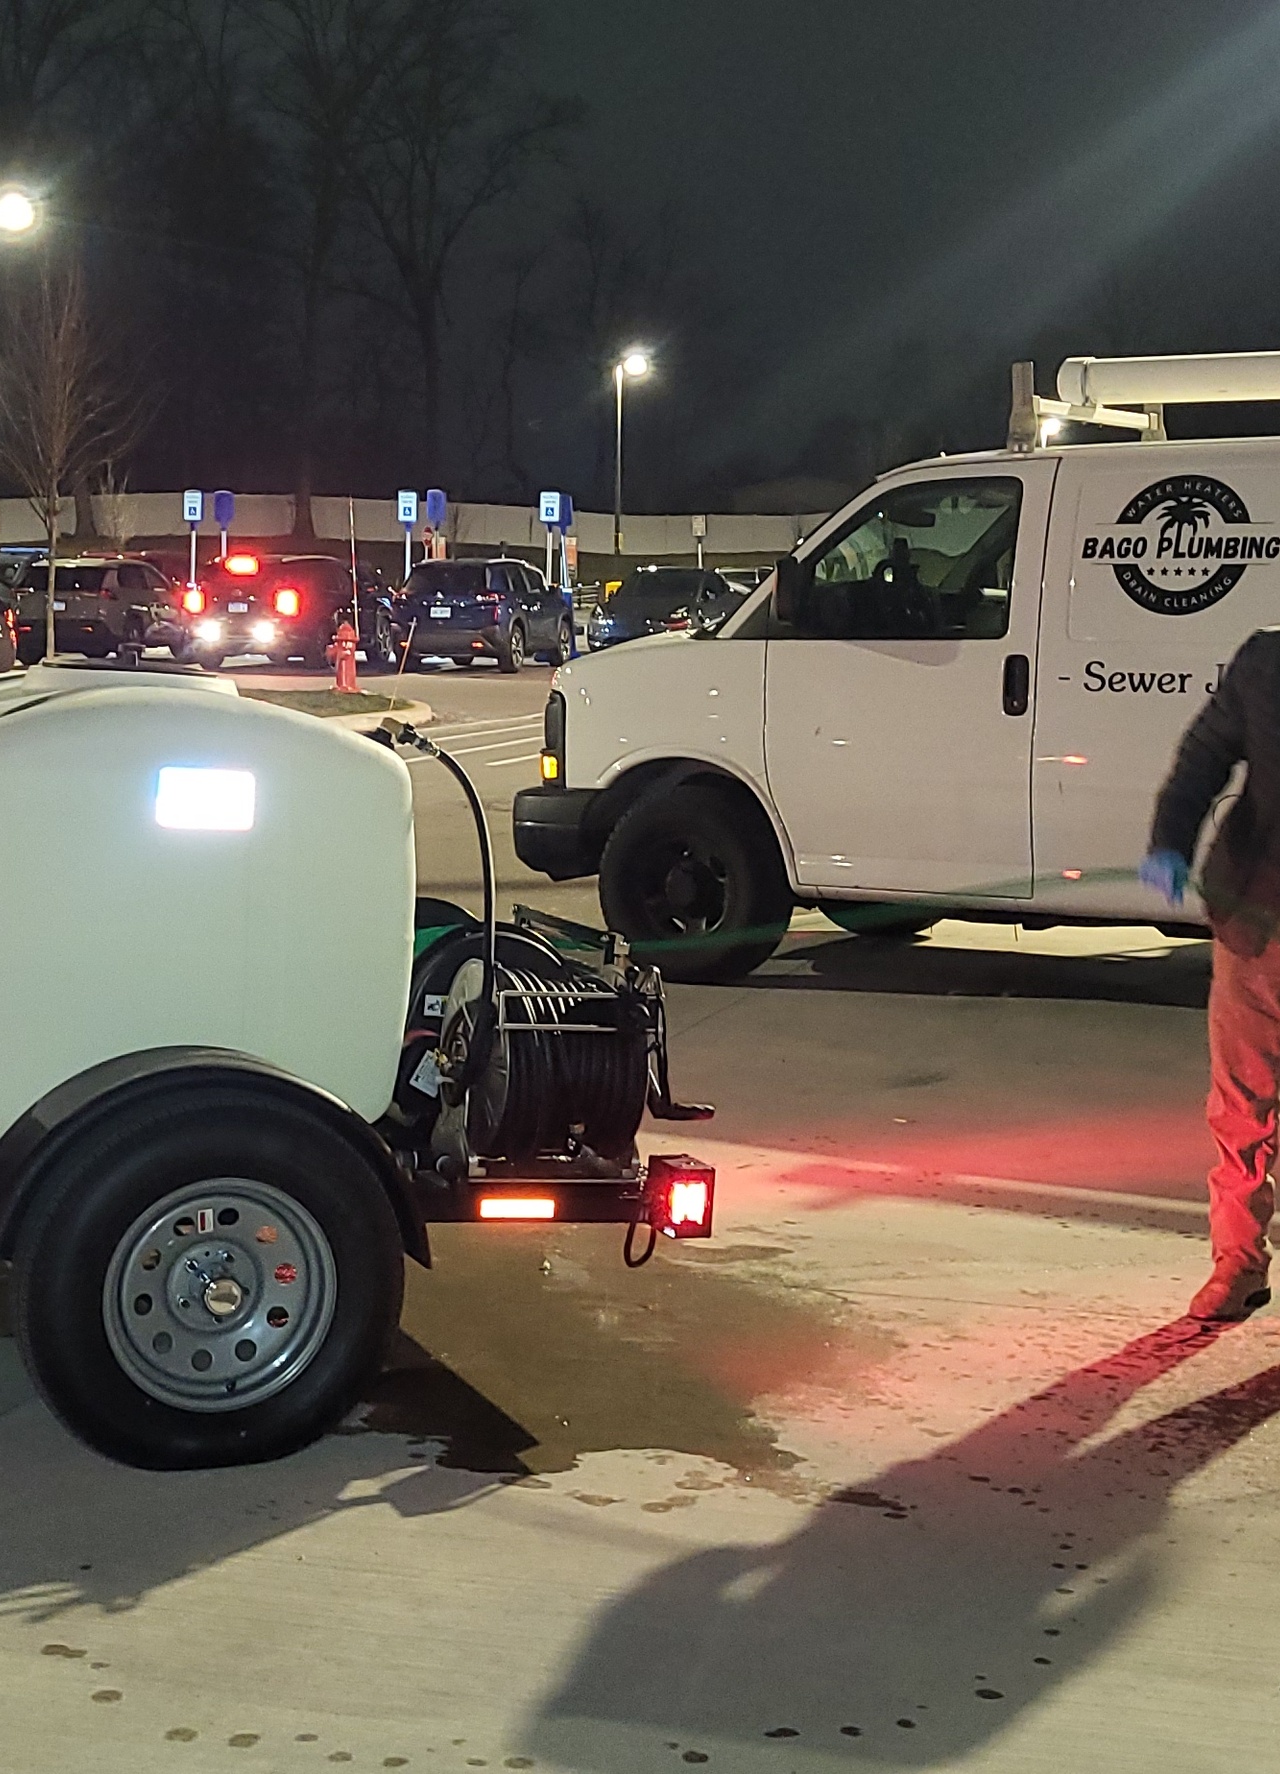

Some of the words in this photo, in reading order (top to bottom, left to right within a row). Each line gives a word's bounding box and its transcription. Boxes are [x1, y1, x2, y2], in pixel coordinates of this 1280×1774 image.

[1126, 484, 1174, 519] WATER
[1183, 481, 1243, 519] HEATERS
[1081, 536, 1148, 559] BAGO
[1156, 536, 1280, 559] PLUMBING
[1122, 571, 1158, 603] DRAIN
[1163, 576, 1233, 608] CLEANING
[1083, 660, 1193, 694] Sewer
